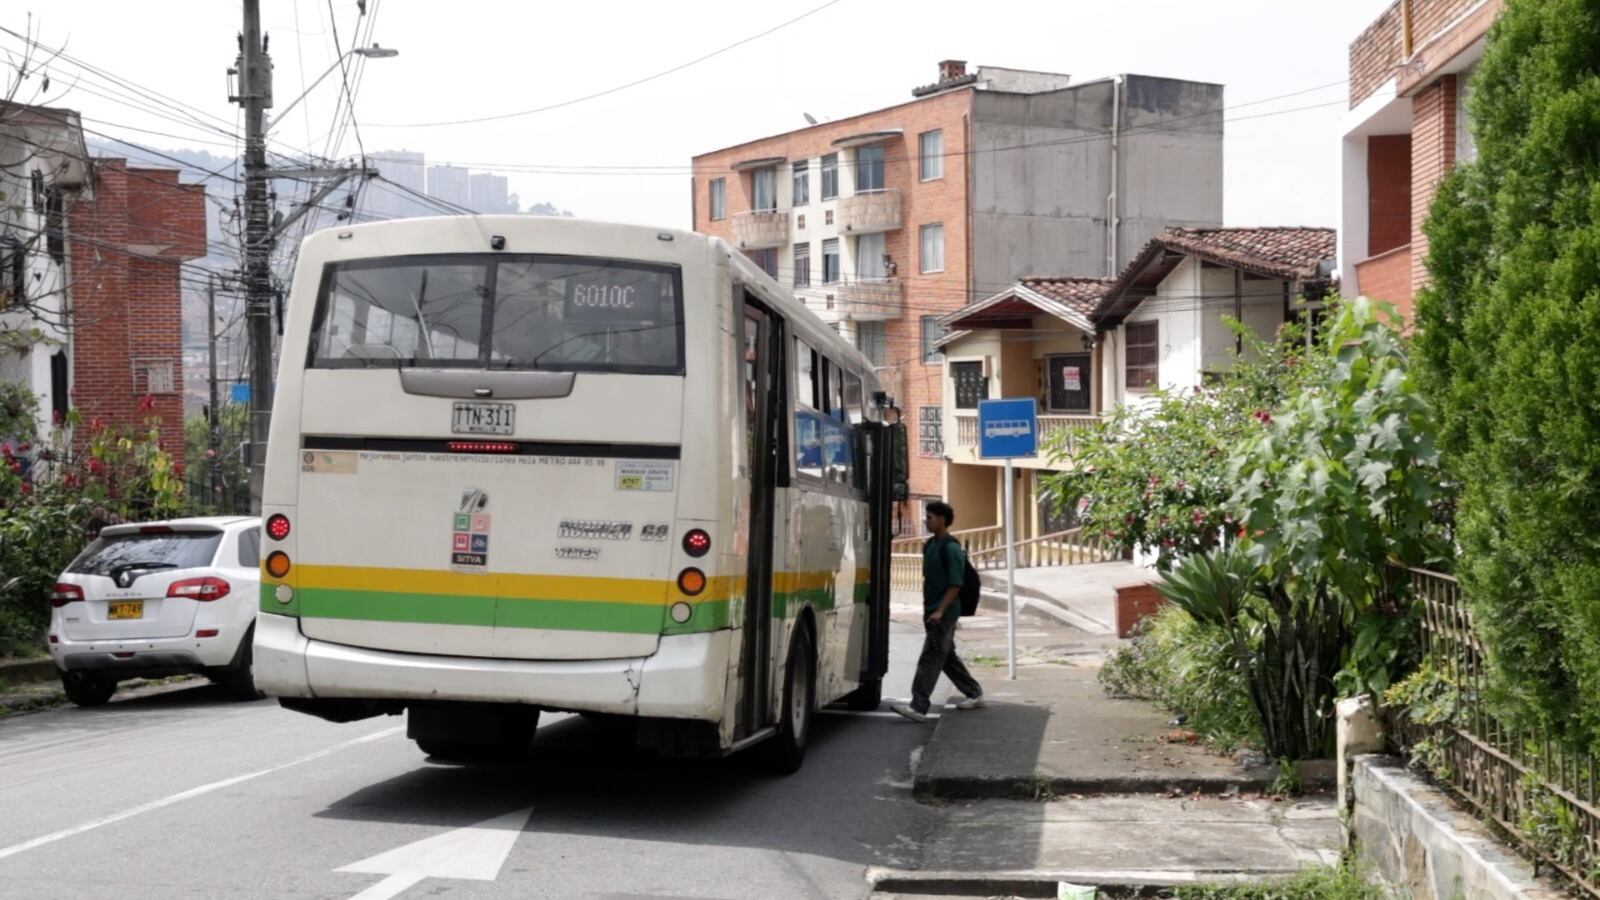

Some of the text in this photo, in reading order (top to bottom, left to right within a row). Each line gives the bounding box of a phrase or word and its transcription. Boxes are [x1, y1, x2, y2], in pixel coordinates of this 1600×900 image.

[574, 284, 635, 308] 6010C
[455, 405, 511, 427] TTN-311
[538, 456, 567, 466] METRO
[456, 554, 482, 564] SITVA
